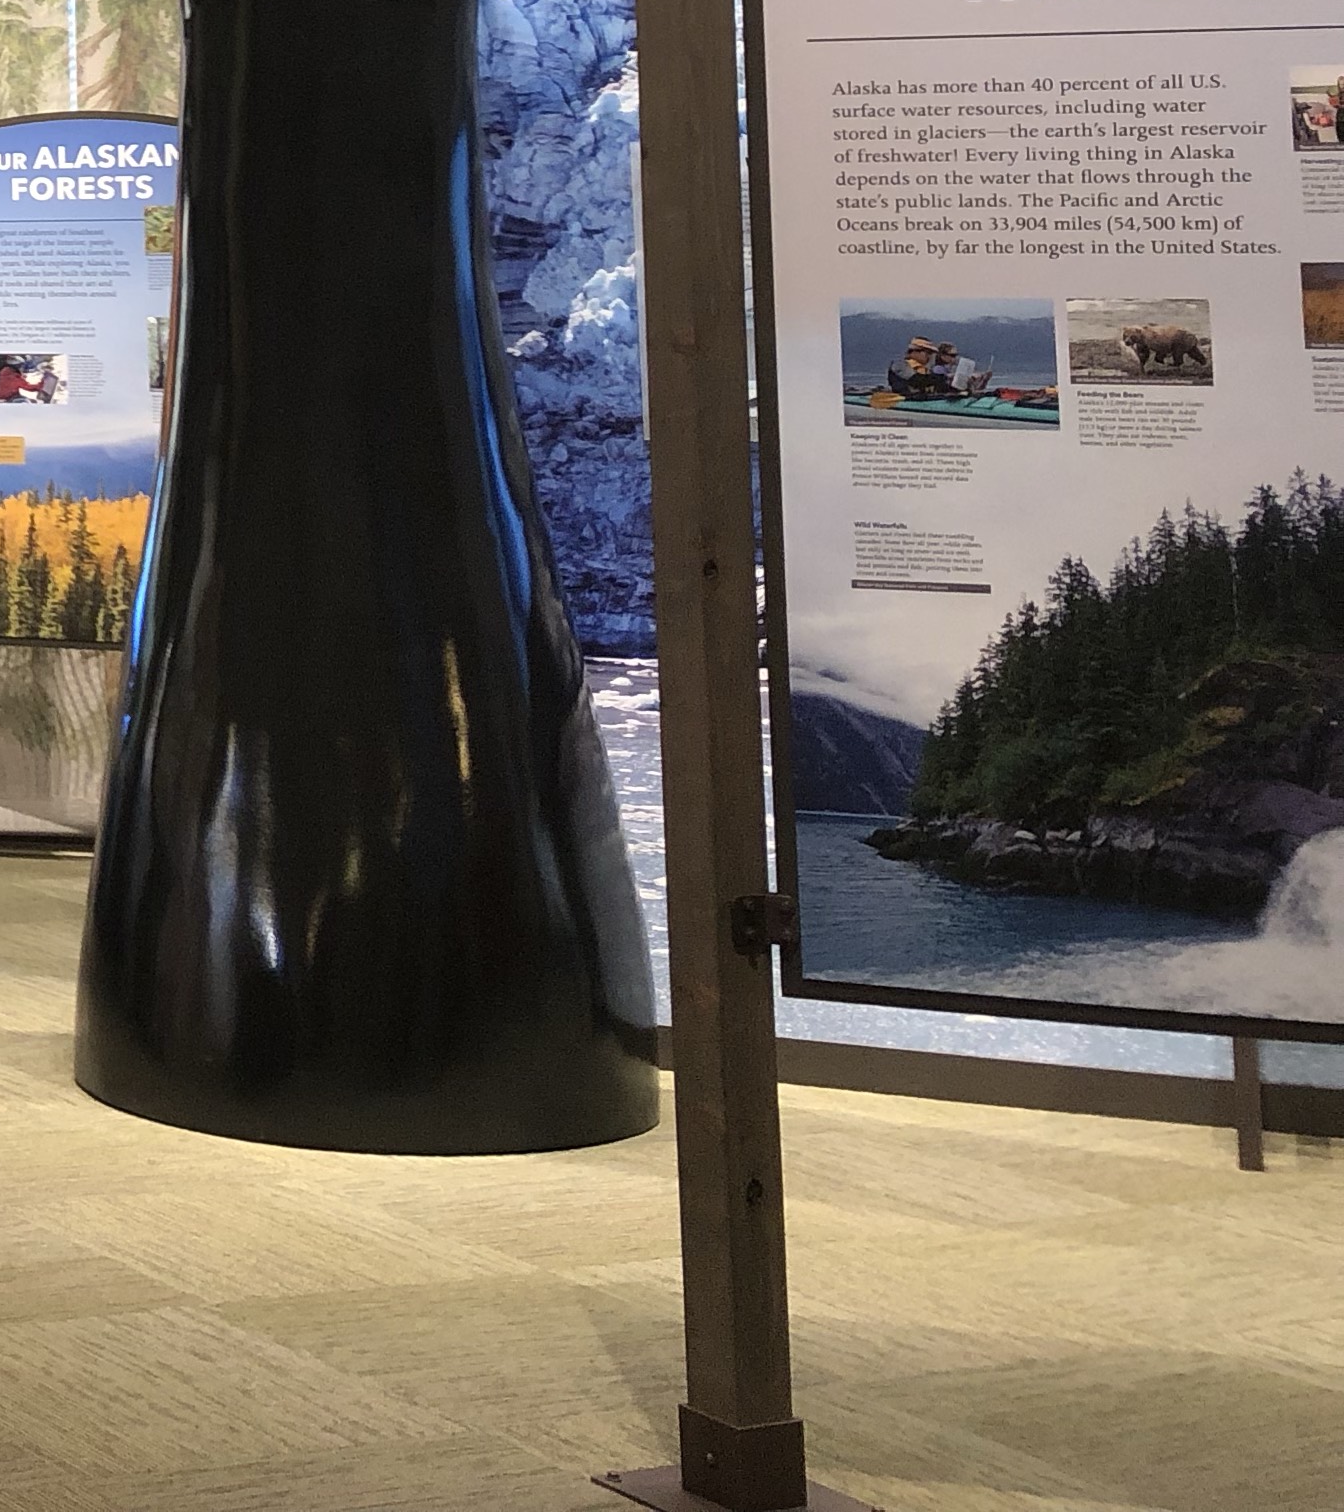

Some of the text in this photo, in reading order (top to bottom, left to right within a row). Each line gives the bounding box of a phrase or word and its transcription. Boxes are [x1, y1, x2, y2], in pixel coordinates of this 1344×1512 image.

[832, 74, 1226, 96] Alaska has more than 40 percent of all U.S.
[833, 97, 1206, 119] surface water resources, including water
[834, 121, 1267, 144] stored in glaciers—the earth's largest reservoir
[834, 144, 1235, 166] of freshwater! Every living thing in Alaska
[11, 175, 154, 201] FORESTS
[836, 168, 1252, 191] depends on the water that flows through the
[836, 192, 1223, 213] state's public lands. The Pacific and Arctic
[837, 215, 1244, 236] Oceans break on 33,904 miles (54,500 km) of
[838, 239, 1281, 259] coastline, by far the longest in the United States.
